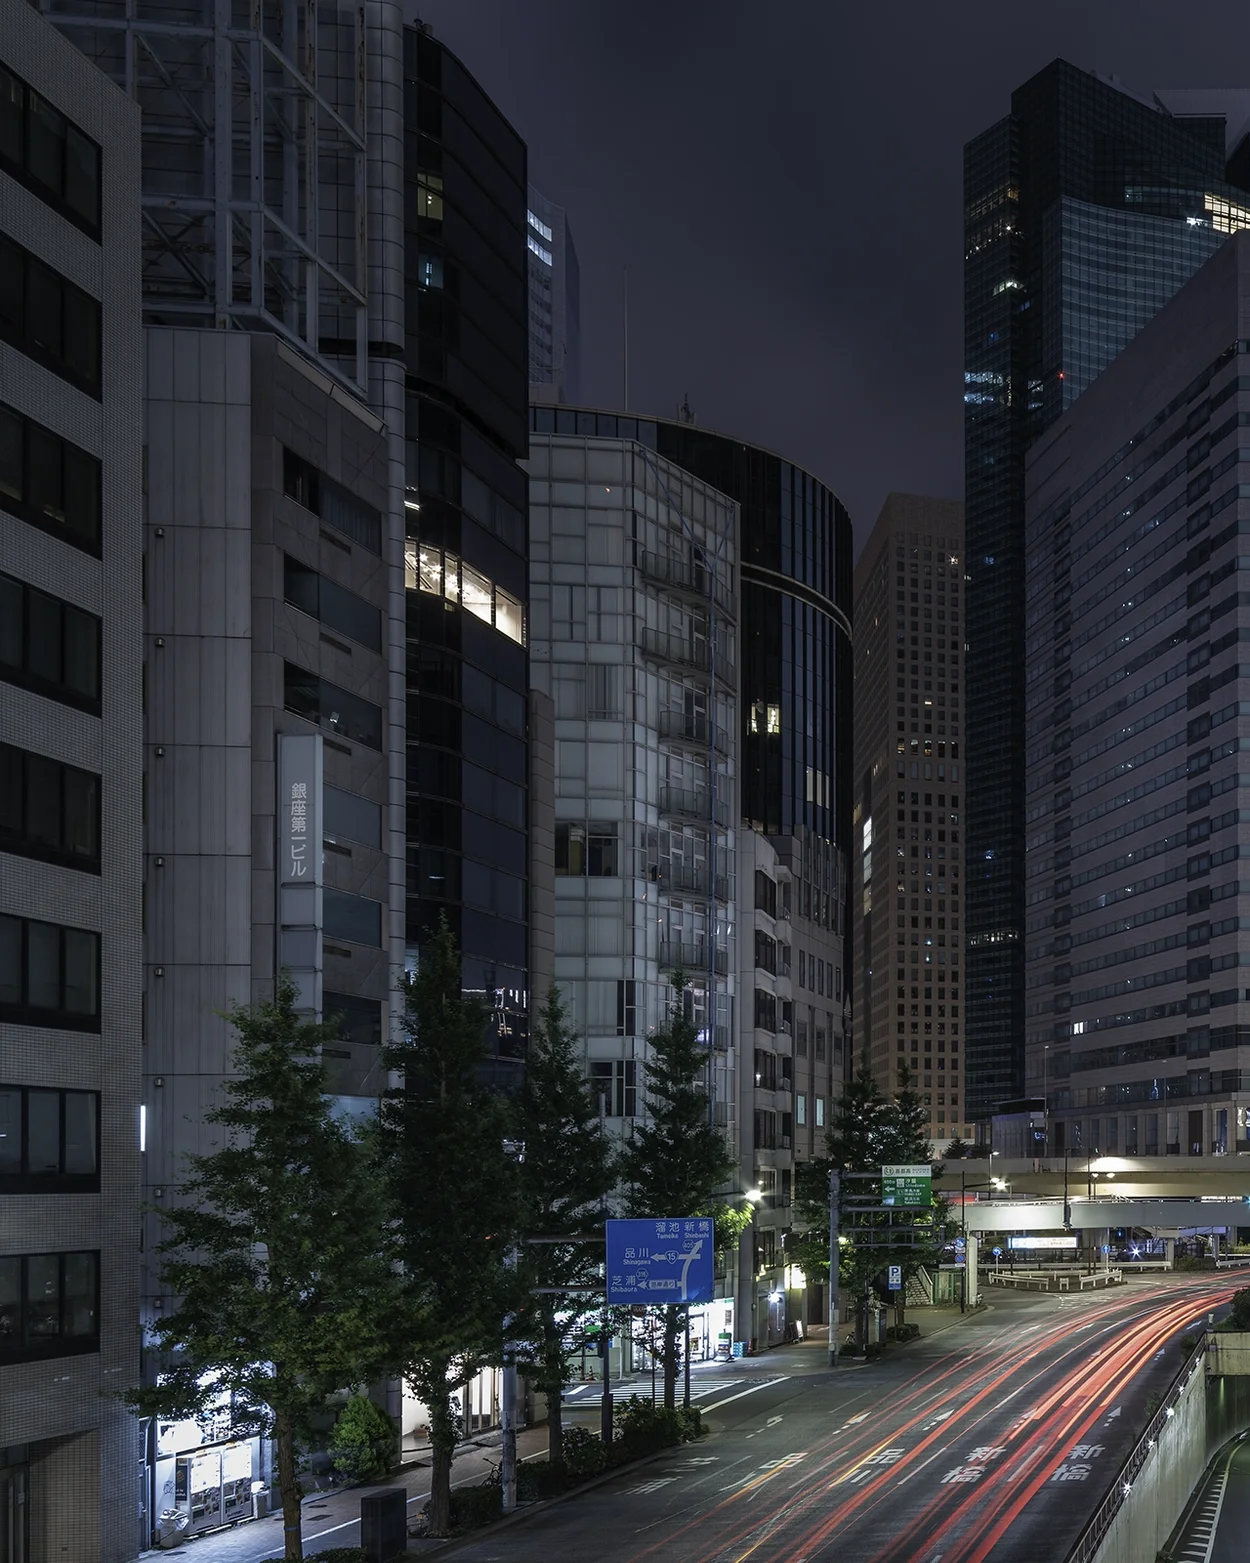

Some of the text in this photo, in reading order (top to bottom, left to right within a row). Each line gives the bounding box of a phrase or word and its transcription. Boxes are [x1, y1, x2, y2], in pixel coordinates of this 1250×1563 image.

[291, 783, 307, 877] 銀座第一ビル
[655, 1222, 710, 1233] 溜池 新橋
[625, 1248, 648, 1258] 品川
[668, 1253, 676, 1261] 15
[623, 1258, 651, 1267] Shinagawa
[891, 1267, 899, 1277] P
[612, 1275, 636, 1286] 芝浦
[939, 1445, 1007, 1484] 新橋
[1050, 1443, 1106, 1482] 新橋
